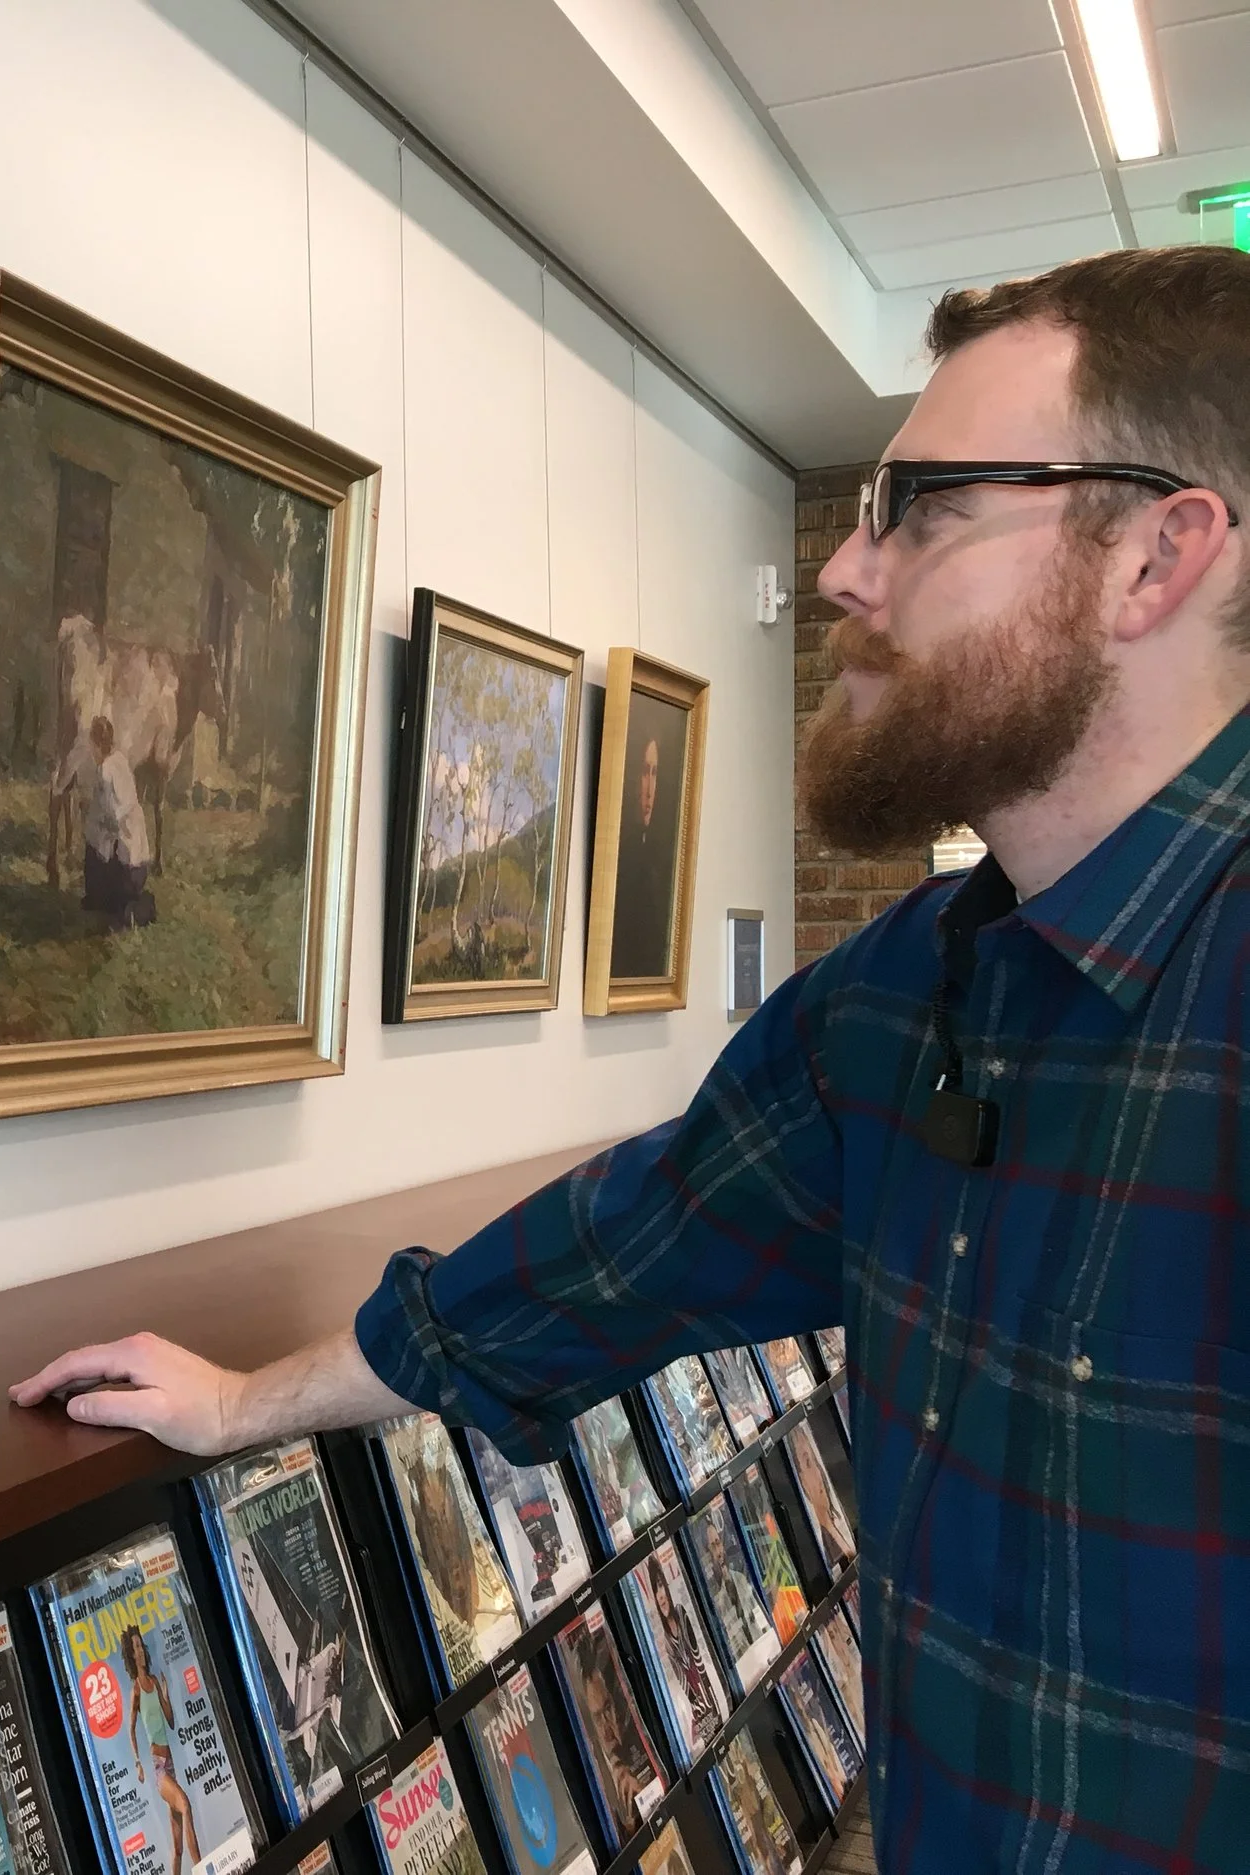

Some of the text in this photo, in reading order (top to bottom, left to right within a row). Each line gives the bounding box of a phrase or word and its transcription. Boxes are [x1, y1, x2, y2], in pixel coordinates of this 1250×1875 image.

[266, 1476, 319, 1520] WORLD
[62, 1600, 88, 1625] Half
[87, 1584, 127, 1615] Marathon
[85, 1666, 112, 1705] 23
[95, 1702, 117, 1724] SHOES
[185, 1697, 207, 1718] Run
[177, 1714, 214, 1746] Strong,
[193, 1732, 218, 1757] Stay
[101, 1760, 116, 1774] Eat
[105, 1767, 129, 1786] Green
[184, 1750, 226, 1786] Healthy,
[108, 1785, 120, 1797] for
[203, 1768, 232, 1796] and...
[111, 1788, 137, 1809] Energy
[127, 1854, 140, 1868] It's
[139, 1844, 156, 1860] Time
[404, 1816, 459, 1875] PERFECT
[138, 1859, 154, 1875] Run
